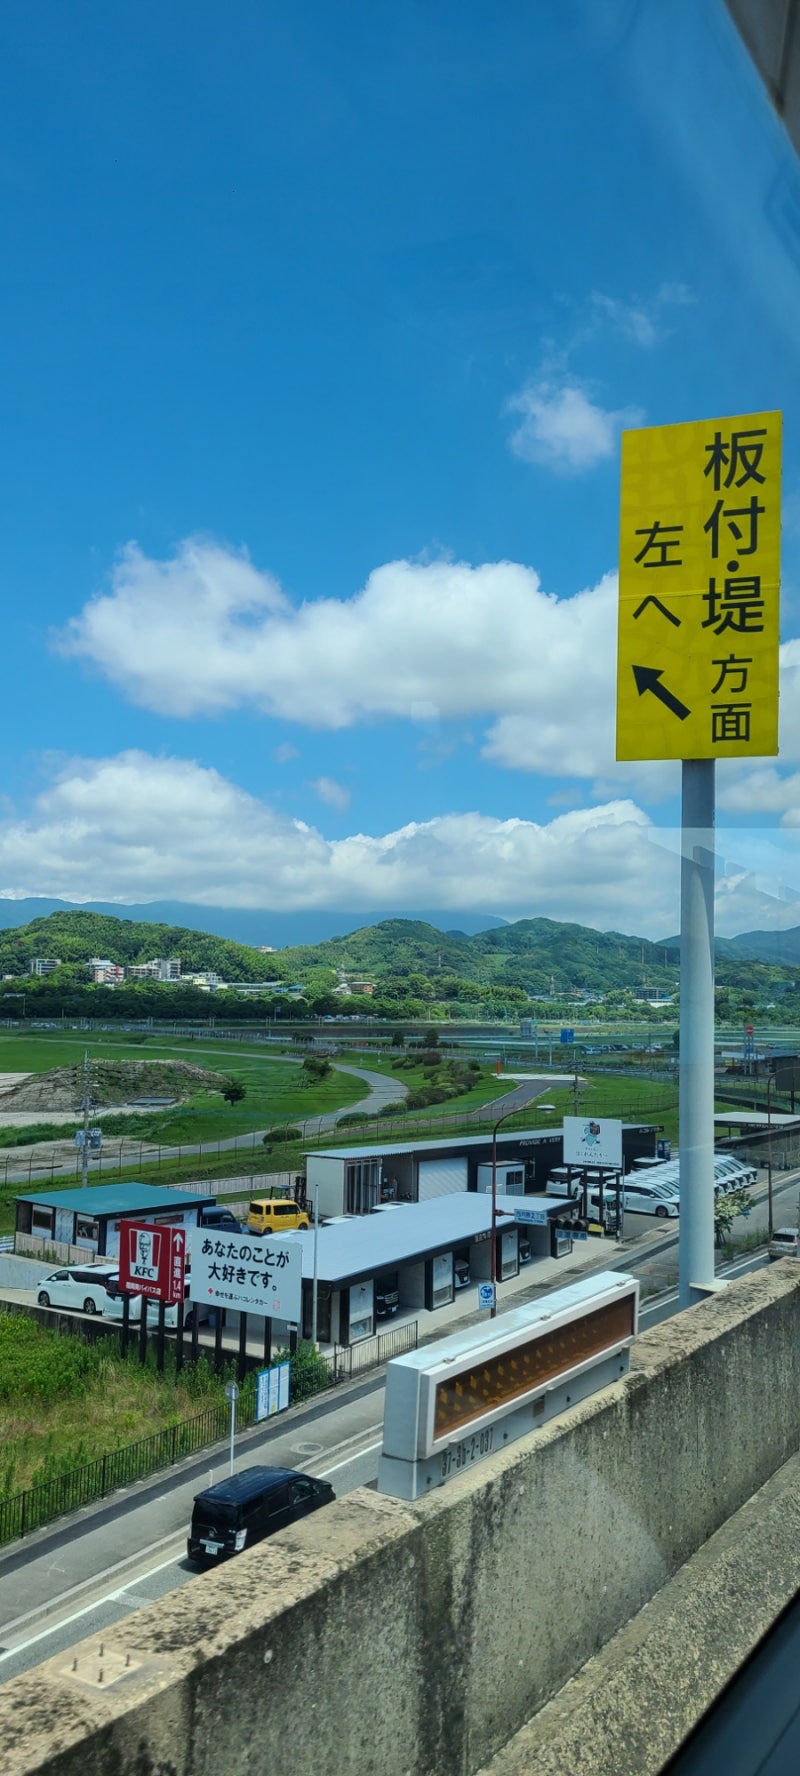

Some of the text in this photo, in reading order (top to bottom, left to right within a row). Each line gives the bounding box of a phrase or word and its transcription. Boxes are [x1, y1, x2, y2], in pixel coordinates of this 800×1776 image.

[633, 521, 684, 628] 左へ
[201, 1238, 289, 1268] あなたのことが
[134, 1266, 155, 1278] KFC
[208, 1262, 278, 1292] 大好きです。
